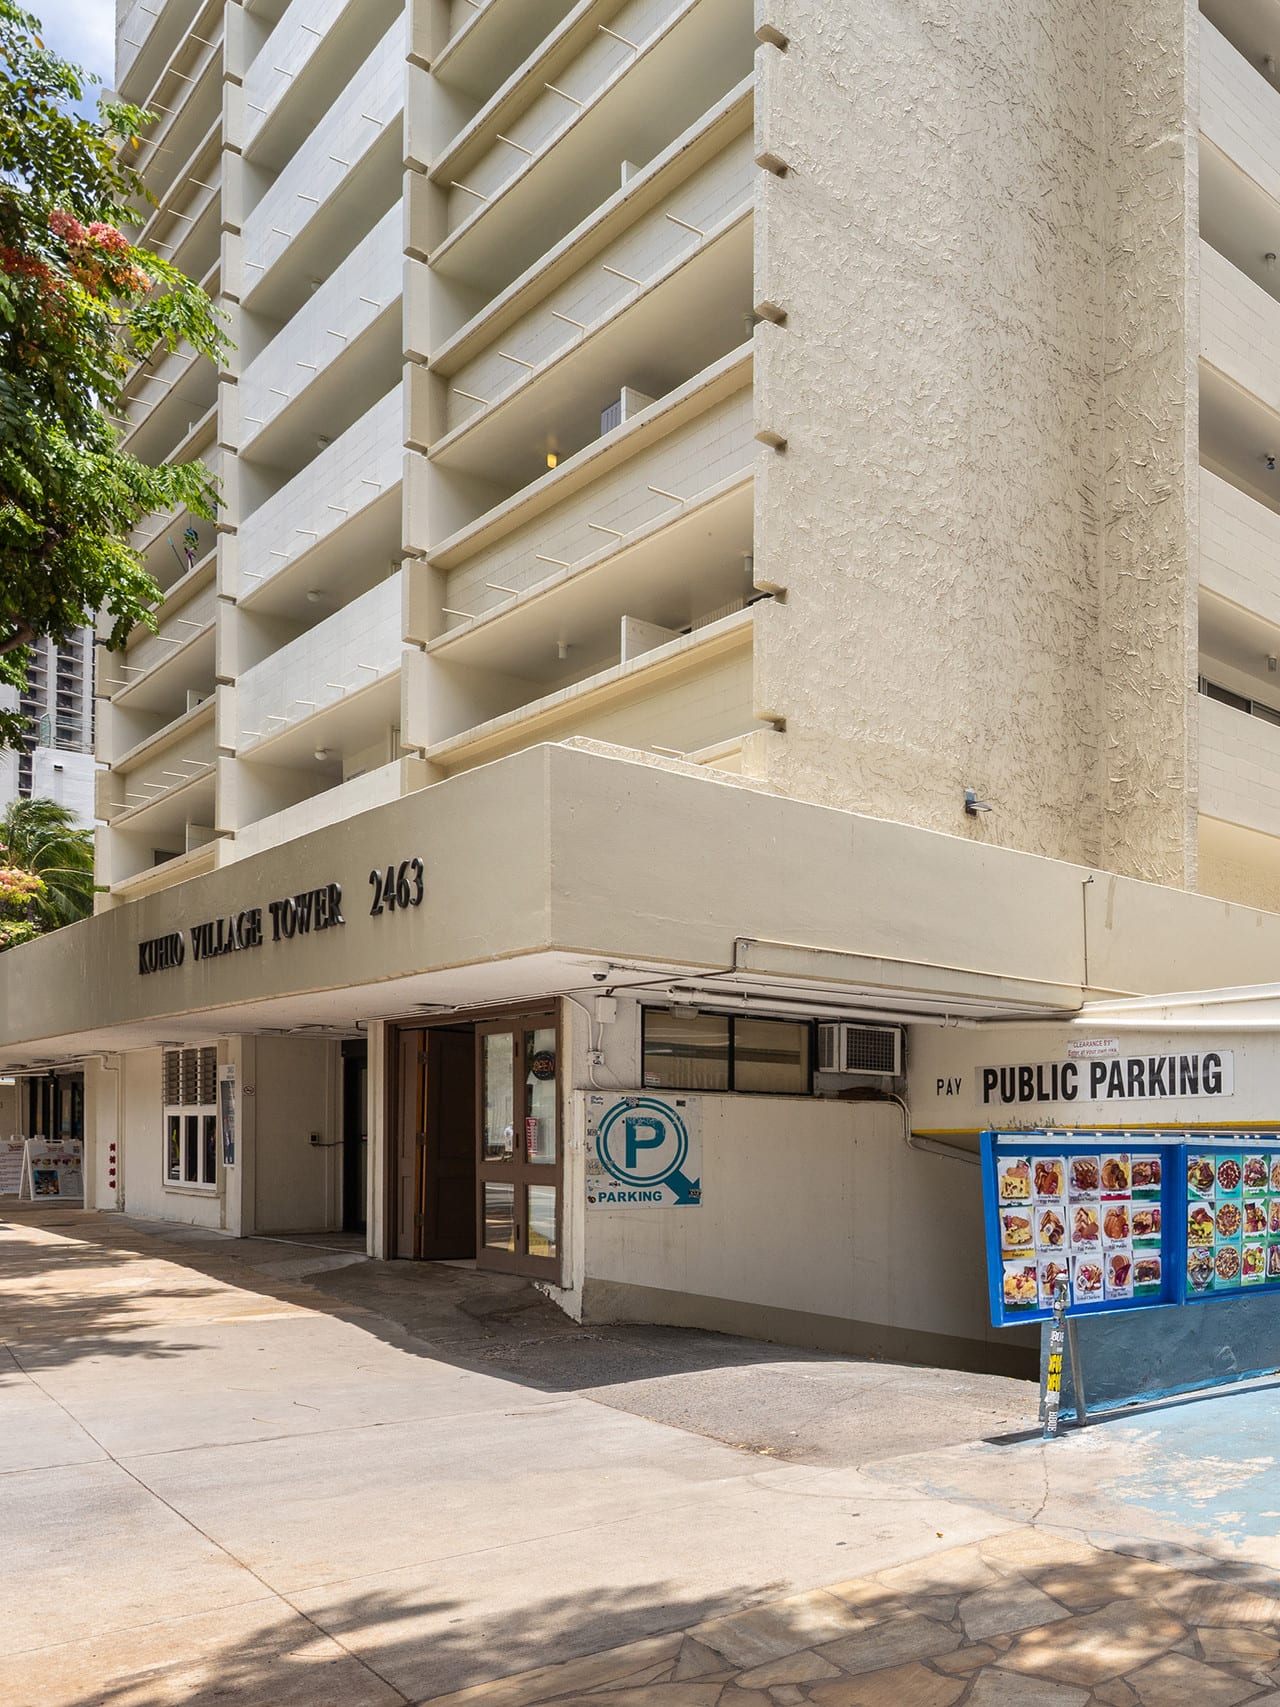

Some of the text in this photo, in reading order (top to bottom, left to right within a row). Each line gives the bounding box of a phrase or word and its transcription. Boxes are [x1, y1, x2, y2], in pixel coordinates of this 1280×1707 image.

[369, 856, 424, 915] 2463
[138, 882, 345, 975] KUHIO VILLAGE TOWER
[1073, 1040, 1102, 1048] CLEARANCE
[937, 1078, 961, 1095] PAY
[983, 1053, 1222, 1103] PUBLIC PARKING
[626, 1117, 665, 1168] P
[598, 1191, 662, 1203] PARKING
